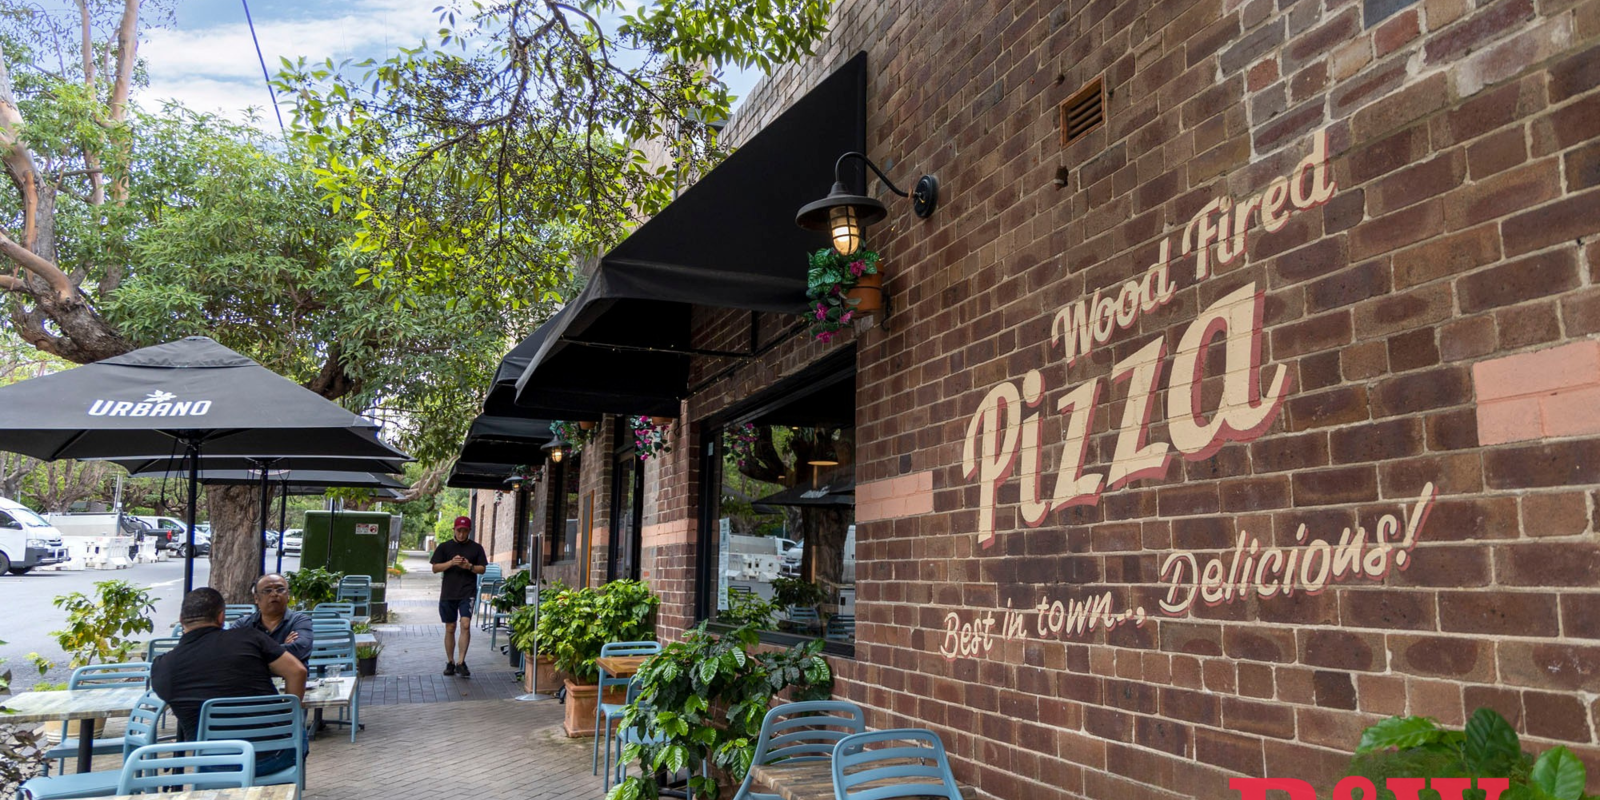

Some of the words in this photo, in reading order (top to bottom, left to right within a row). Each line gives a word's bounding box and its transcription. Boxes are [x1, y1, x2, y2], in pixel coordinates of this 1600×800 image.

[1051, 238, 1176, 366] Wood
[1182, 130, 1337, 281] Fired
[88, 399, 212, 417] URBANO
[962, 281, 1292, 548] Pizza
[940, 611, 995, 661] Best
[1002, 597, 1028, 642] in
[1159, 481, 1438, 616] Delicious!
